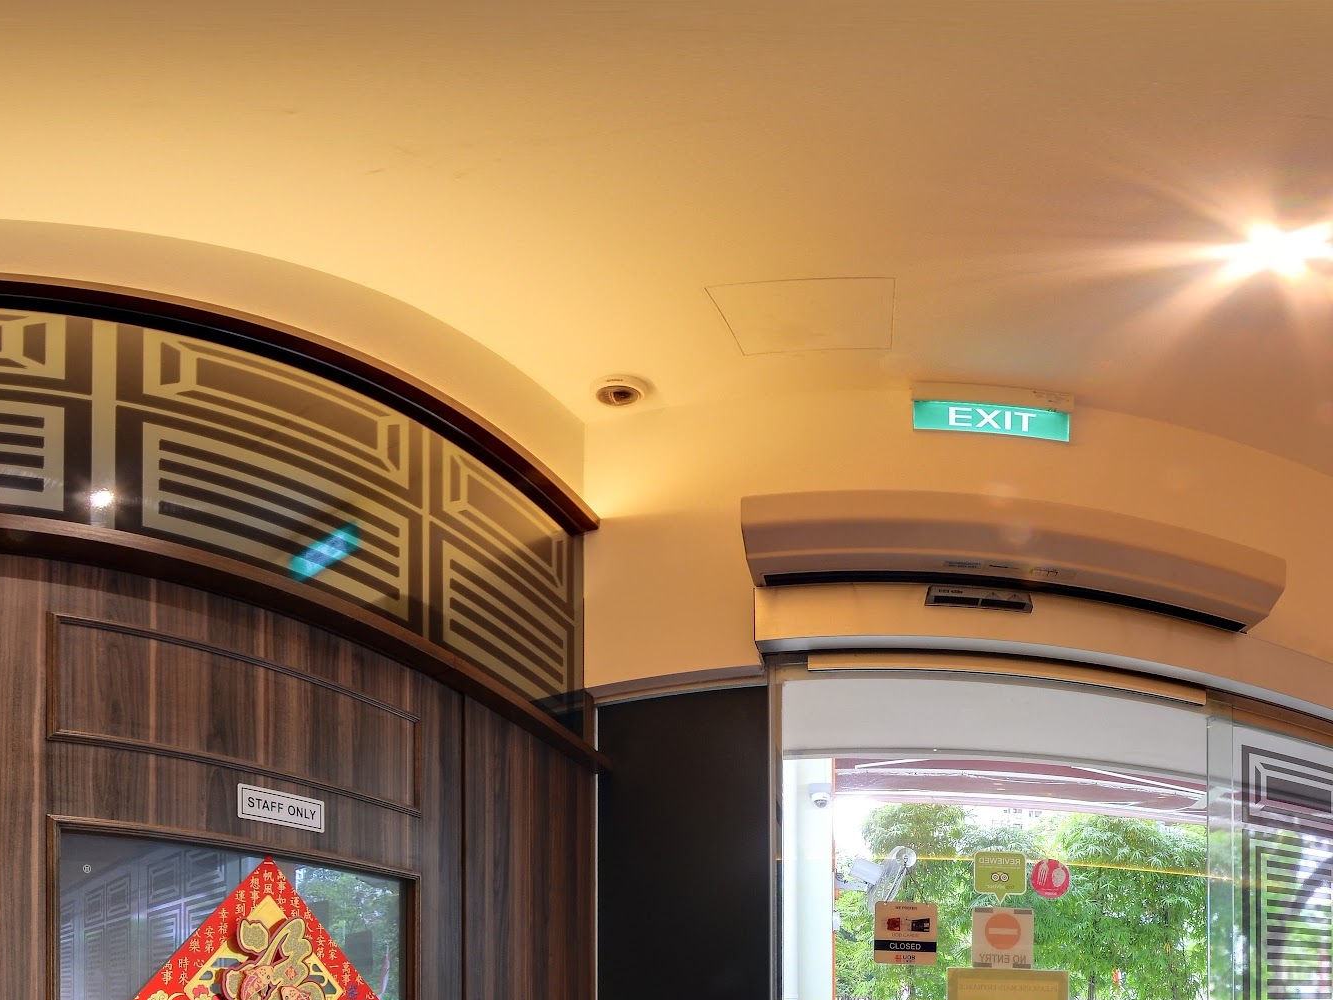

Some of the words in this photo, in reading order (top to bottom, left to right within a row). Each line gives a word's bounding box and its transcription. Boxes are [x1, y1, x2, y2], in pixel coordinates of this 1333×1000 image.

[948, 406, 1037, 432] EXIT
[247, 796, 283, 813] STAFF
[287, 805, 316, 820] ONLY
[889, 942, 922, 951] CLOSED
